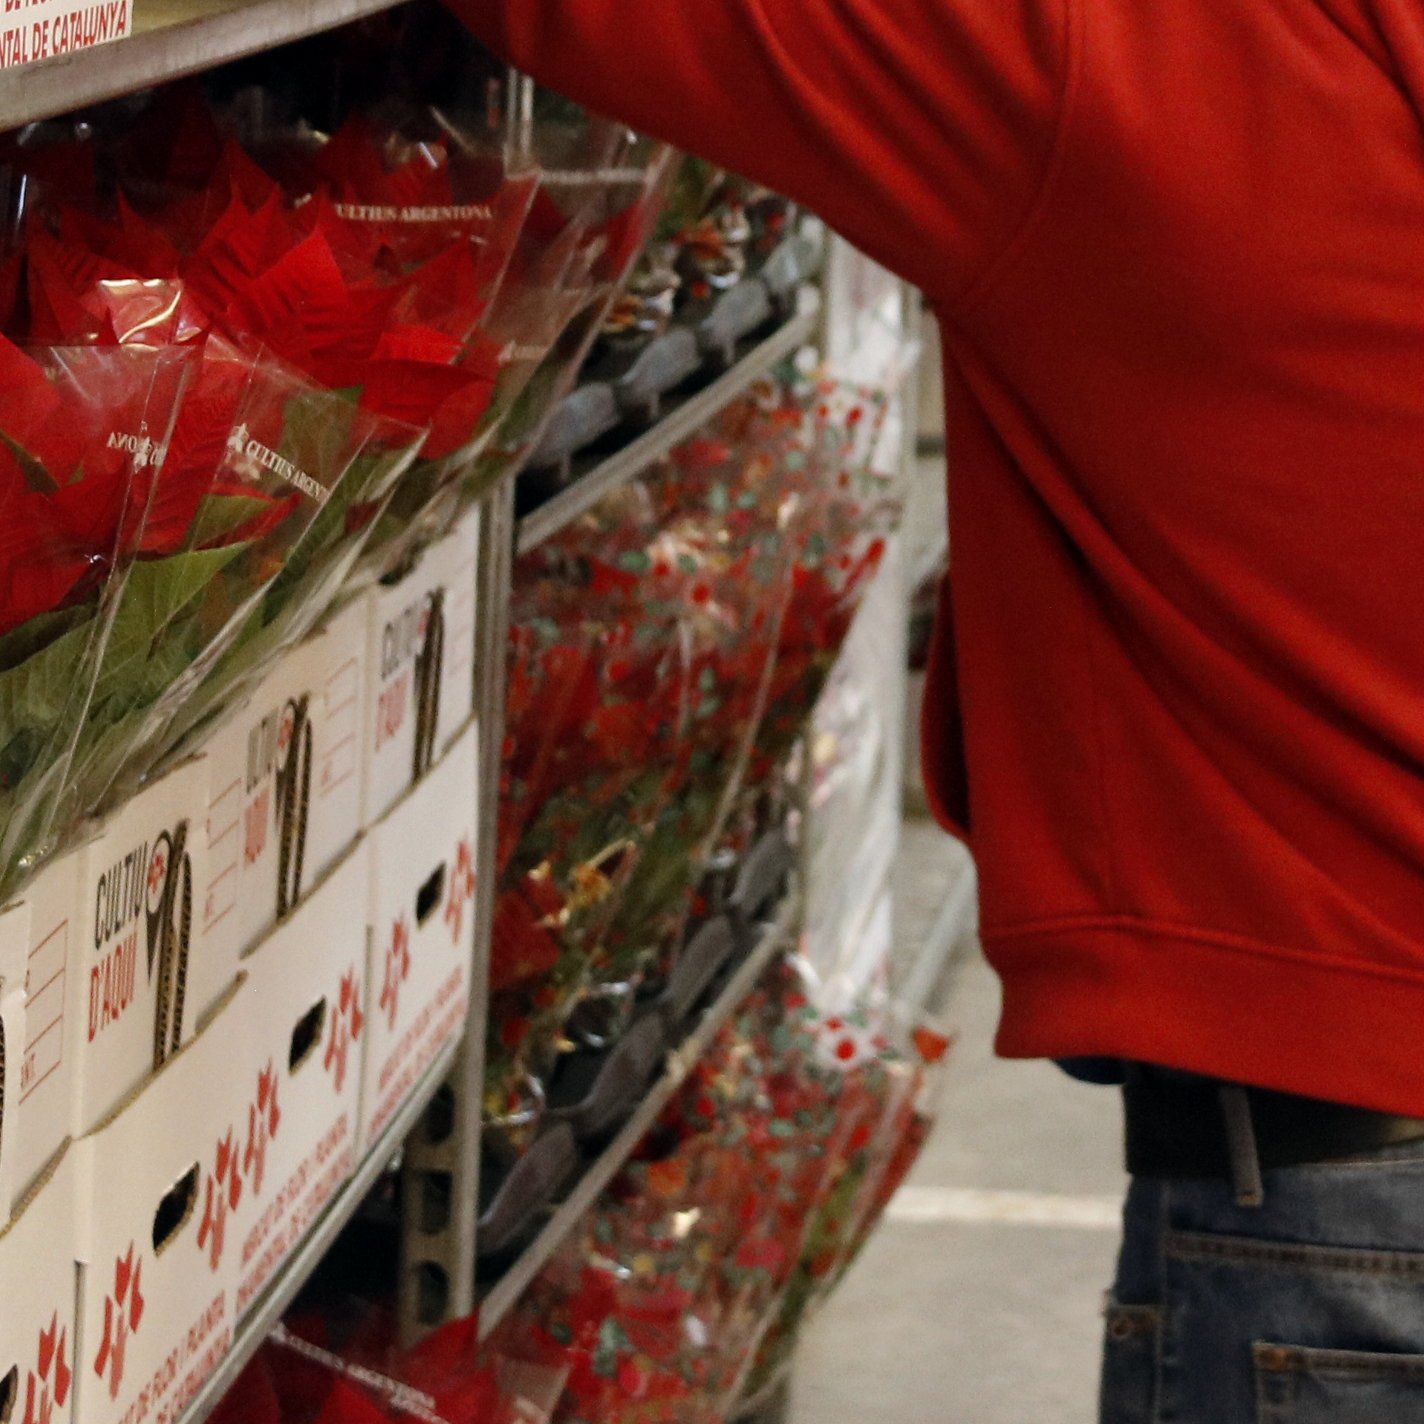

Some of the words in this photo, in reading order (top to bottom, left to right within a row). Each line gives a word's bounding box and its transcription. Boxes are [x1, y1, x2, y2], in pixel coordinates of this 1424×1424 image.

[31, 20, 50, 61] DE
[51, 0, 127, 56] CATALUNYA
[334, 203, 398, 223] ULTIUS
[94, 840, 148, 951] CULTIU
